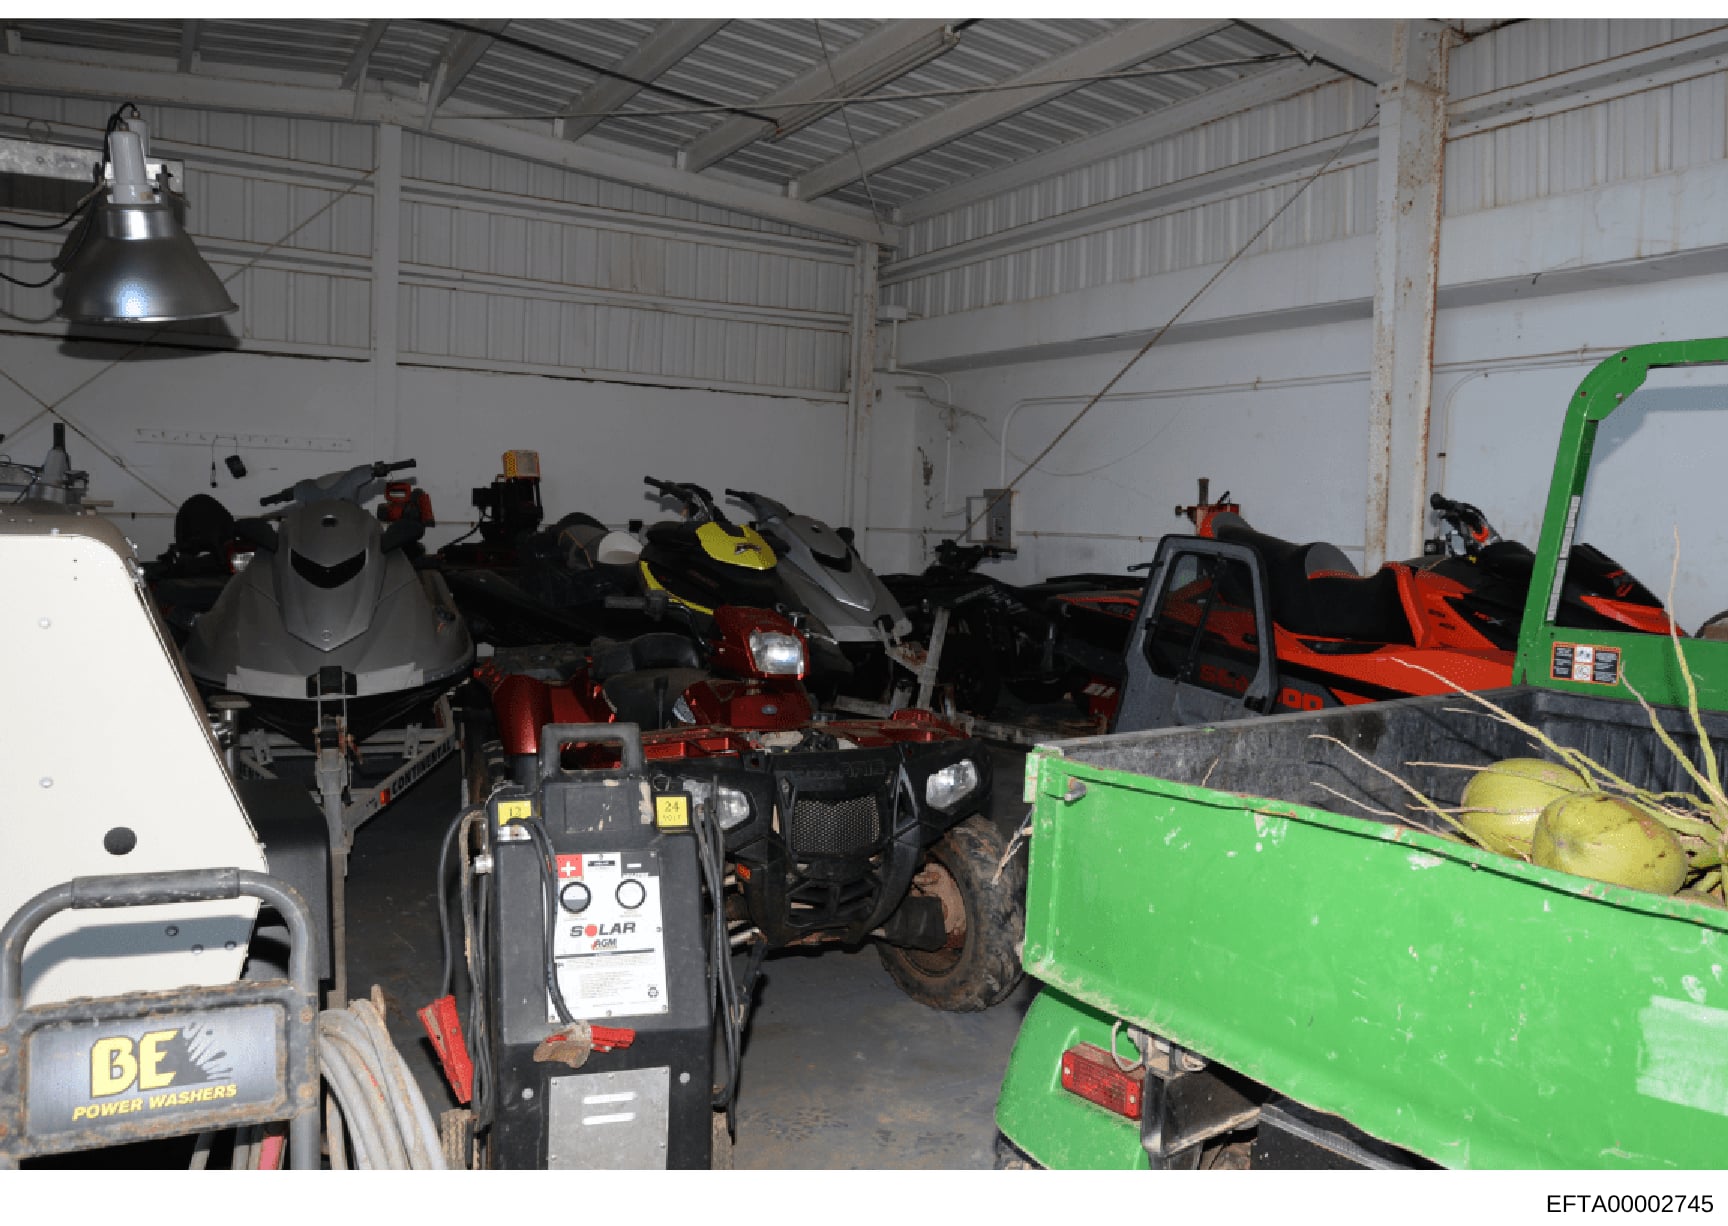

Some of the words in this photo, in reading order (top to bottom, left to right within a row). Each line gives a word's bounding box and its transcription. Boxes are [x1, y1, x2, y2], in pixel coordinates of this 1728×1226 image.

[664, 800, 681, 813] 24
[569, 922, 636, 938] SOLAR
[90, 1028, 179, 1098] BE
[71, 1098, 143, 1121] POWER
[149, 1084, 238, 1109] WASHERS
